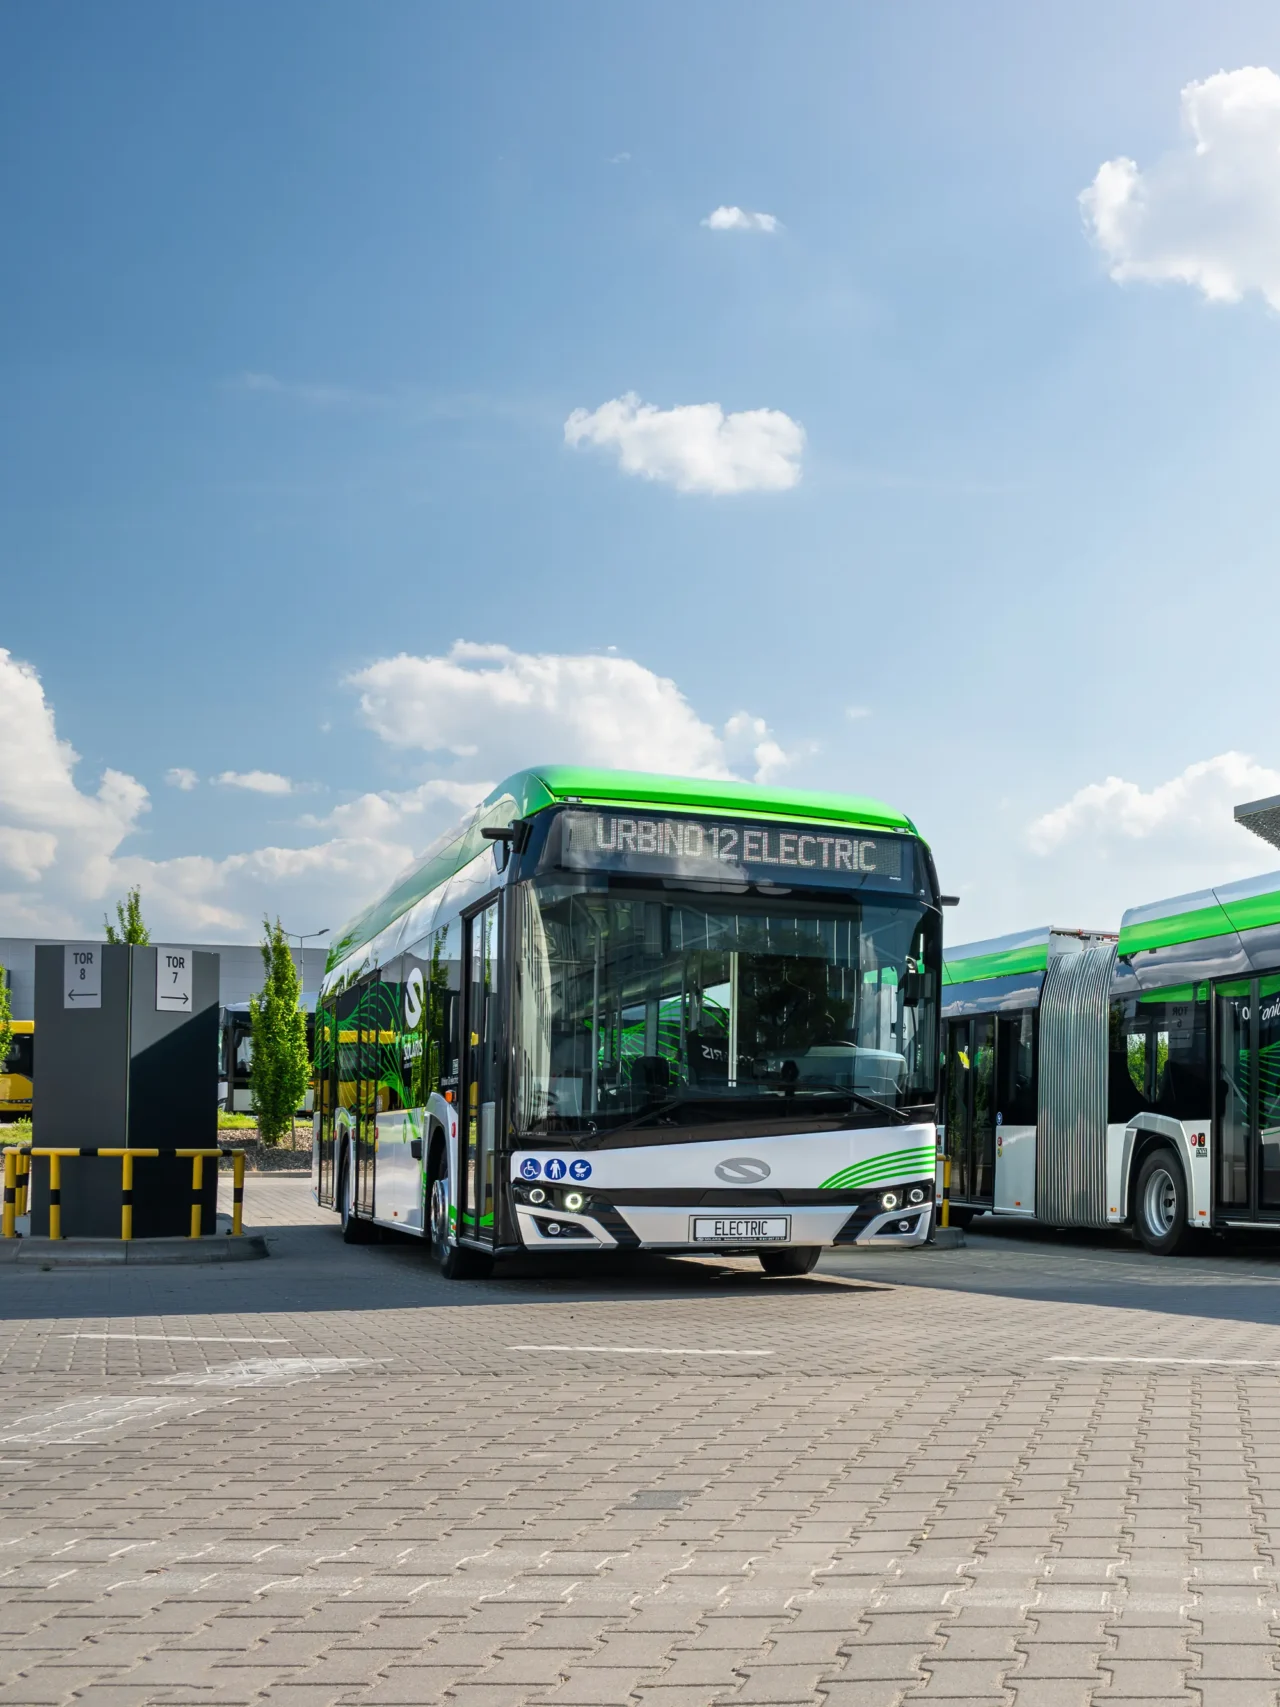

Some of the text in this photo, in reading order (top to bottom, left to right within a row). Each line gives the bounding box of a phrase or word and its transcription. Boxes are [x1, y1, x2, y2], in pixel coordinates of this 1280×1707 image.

[597, 817, 877, 872] URBINO 12 ELECTRIC
[73, 952, 93, 965] TOR
[166, 955, 185, 969] TOR
[79, 967, 86, 980] 8
[172, 971, 179, 984] 7
[714, 1220, 768, 1236] ELECTRIC
